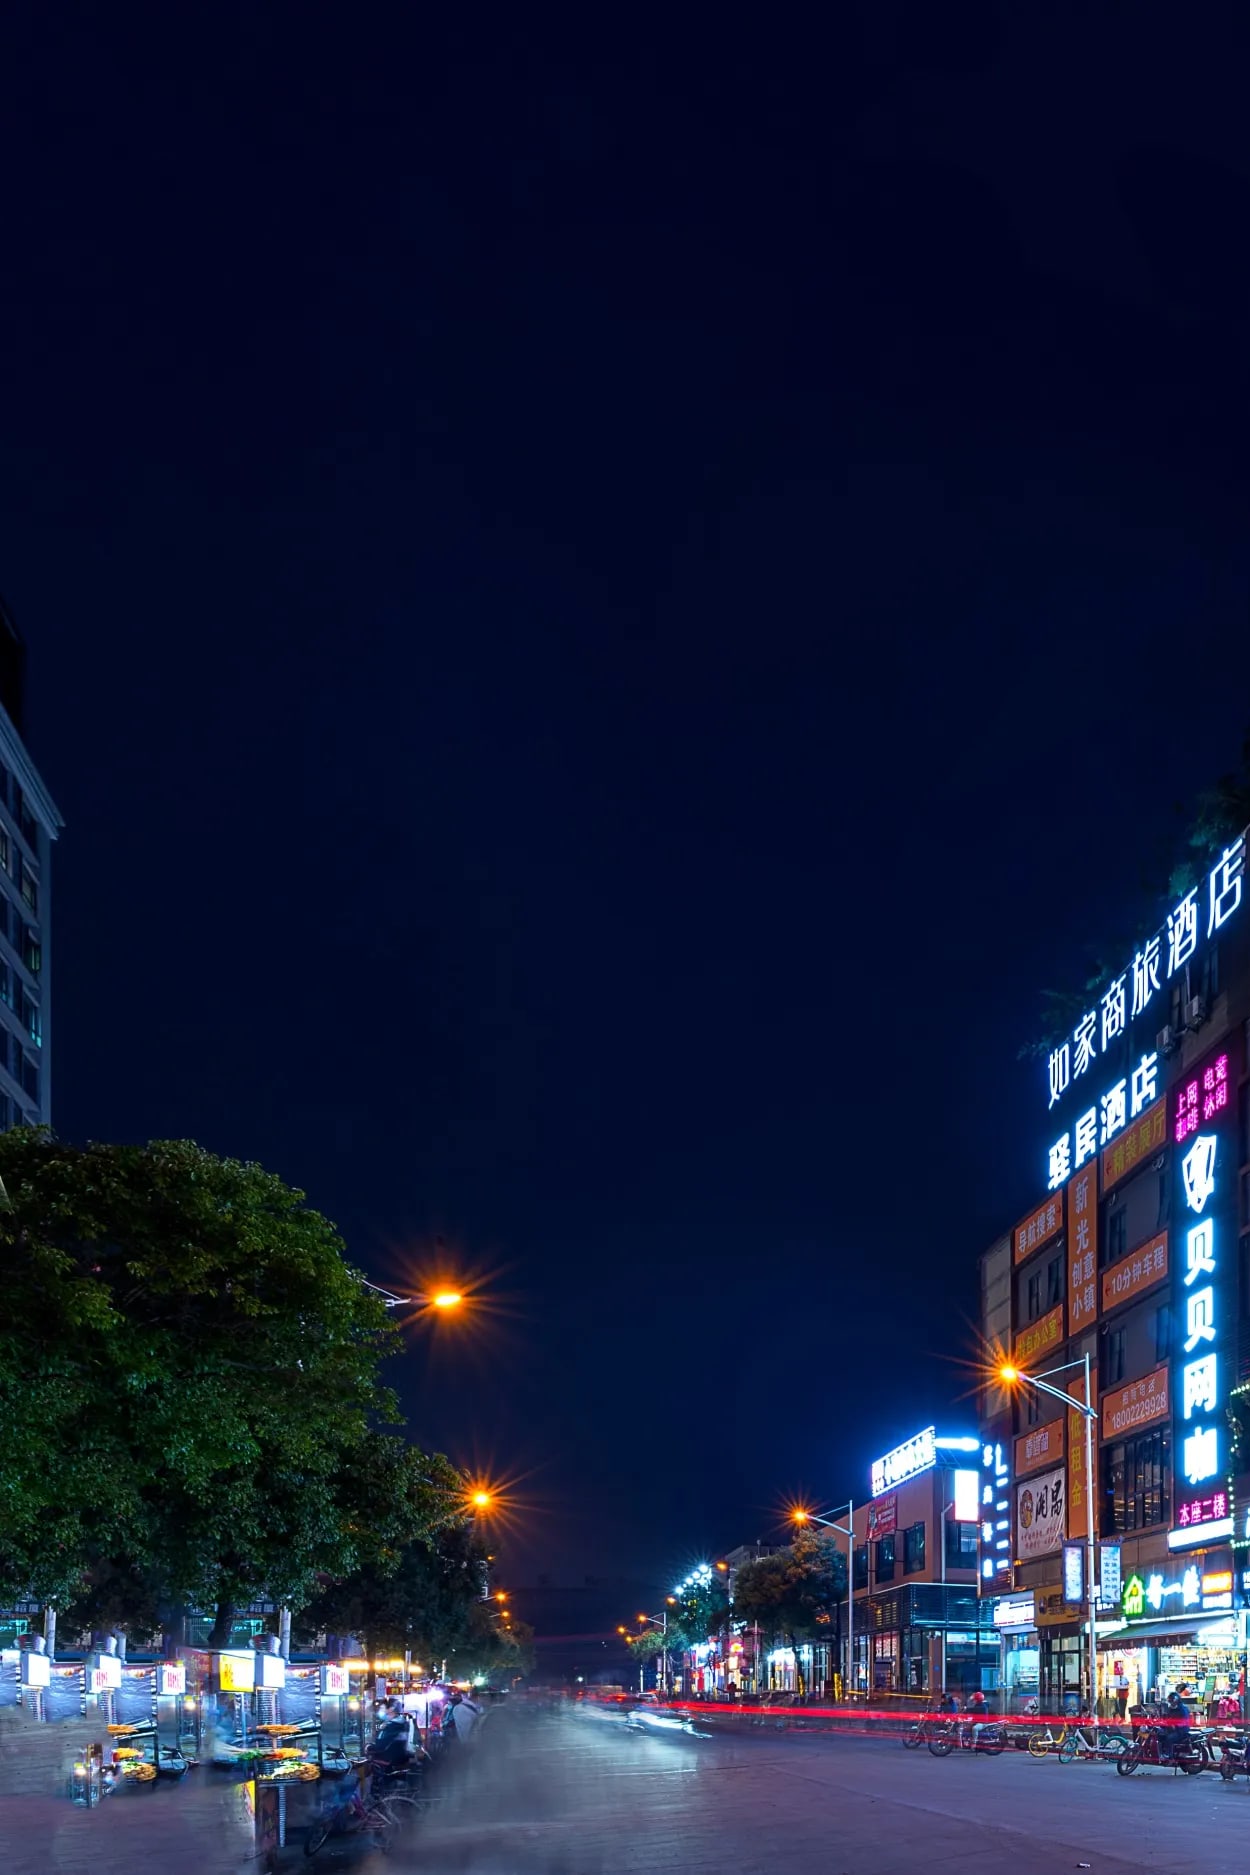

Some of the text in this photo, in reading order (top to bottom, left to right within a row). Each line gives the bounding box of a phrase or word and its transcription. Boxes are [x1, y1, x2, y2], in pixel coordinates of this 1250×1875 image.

[1048, 838, 1244, 1110] 如家商旅酒店
[1175, 1081, 1227, 1142] 咖啡 休闲
[1176, 1054, 1227, 1119] 上网 电竞
[1017, 1203, 1057, 1253] 导航搜索
[1110, 1245, 1165, 1296] 10分钟车程
[1183, 1217, 1218, 1485] 贝贝网咖
[1179, 1492, 1227, 1528] 本座二楼
